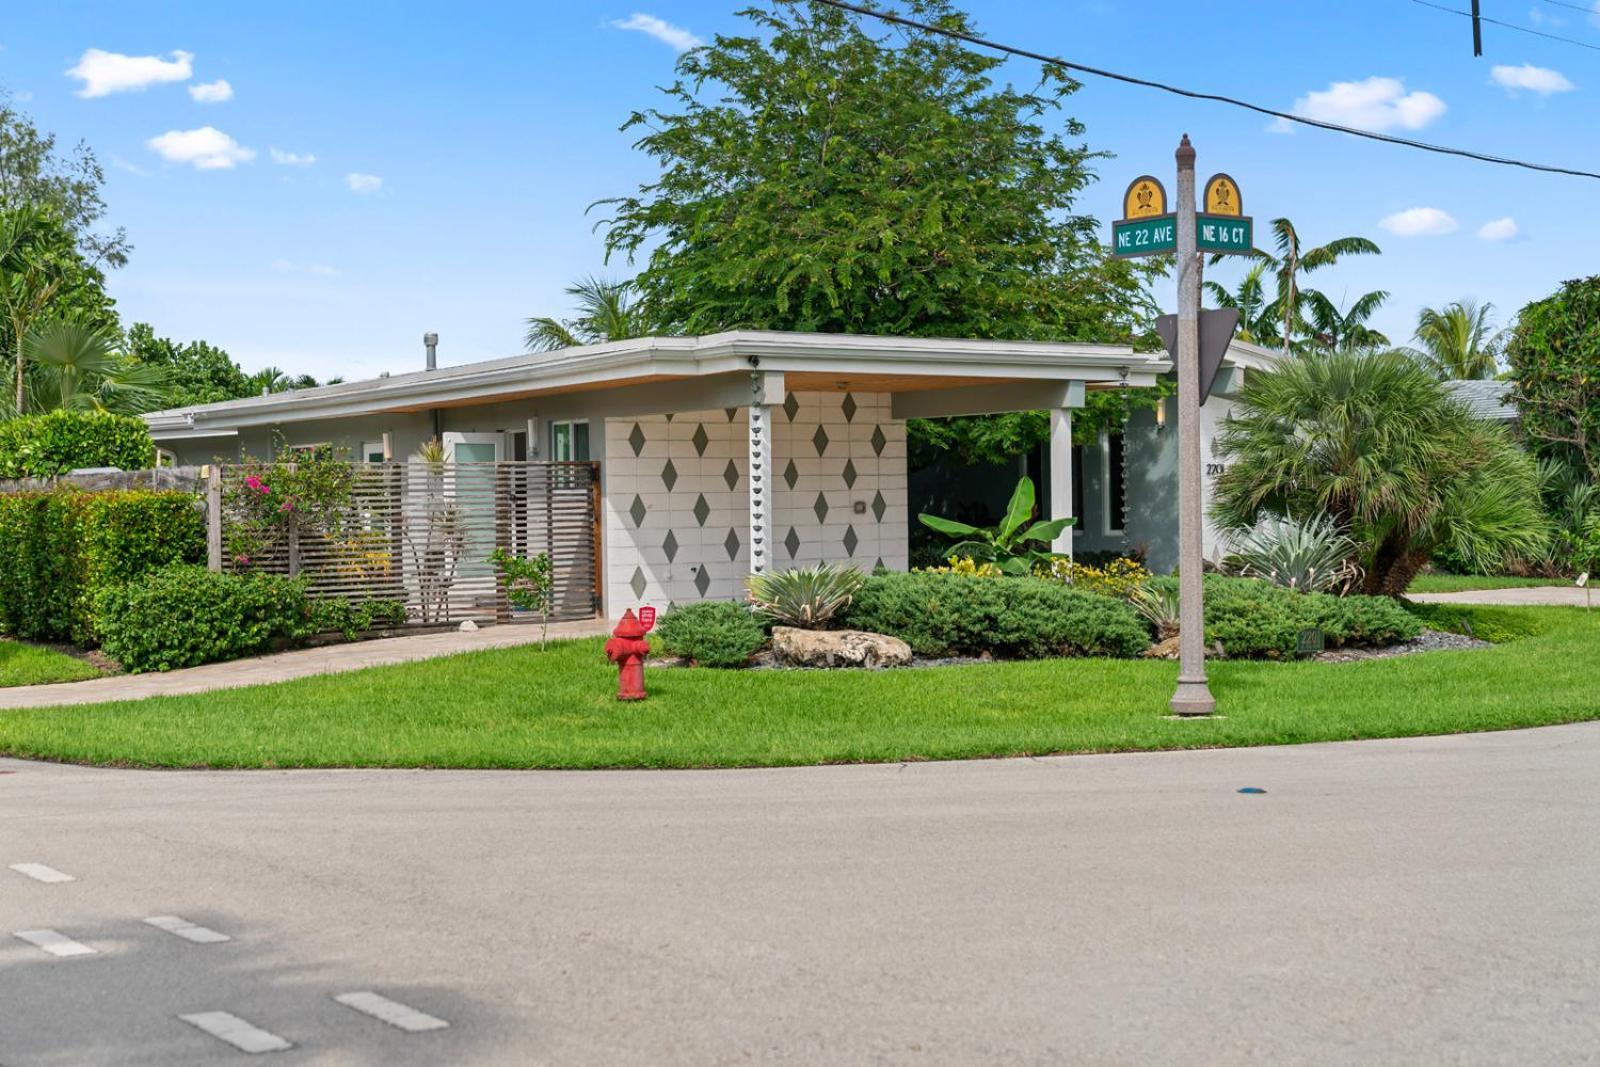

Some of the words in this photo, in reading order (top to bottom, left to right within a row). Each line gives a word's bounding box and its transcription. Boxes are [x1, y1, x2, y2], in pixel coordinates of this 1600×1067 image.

[1118, 231, 1132, 248] NE
[1135, 229, 1149, 246] 22
[1153, 226, 1173, 243] AVE
[1203, 224, 1216, 242] NE
[1219, 226, 1229, 243] 16
[1232, 227, 1245, 244] CT
